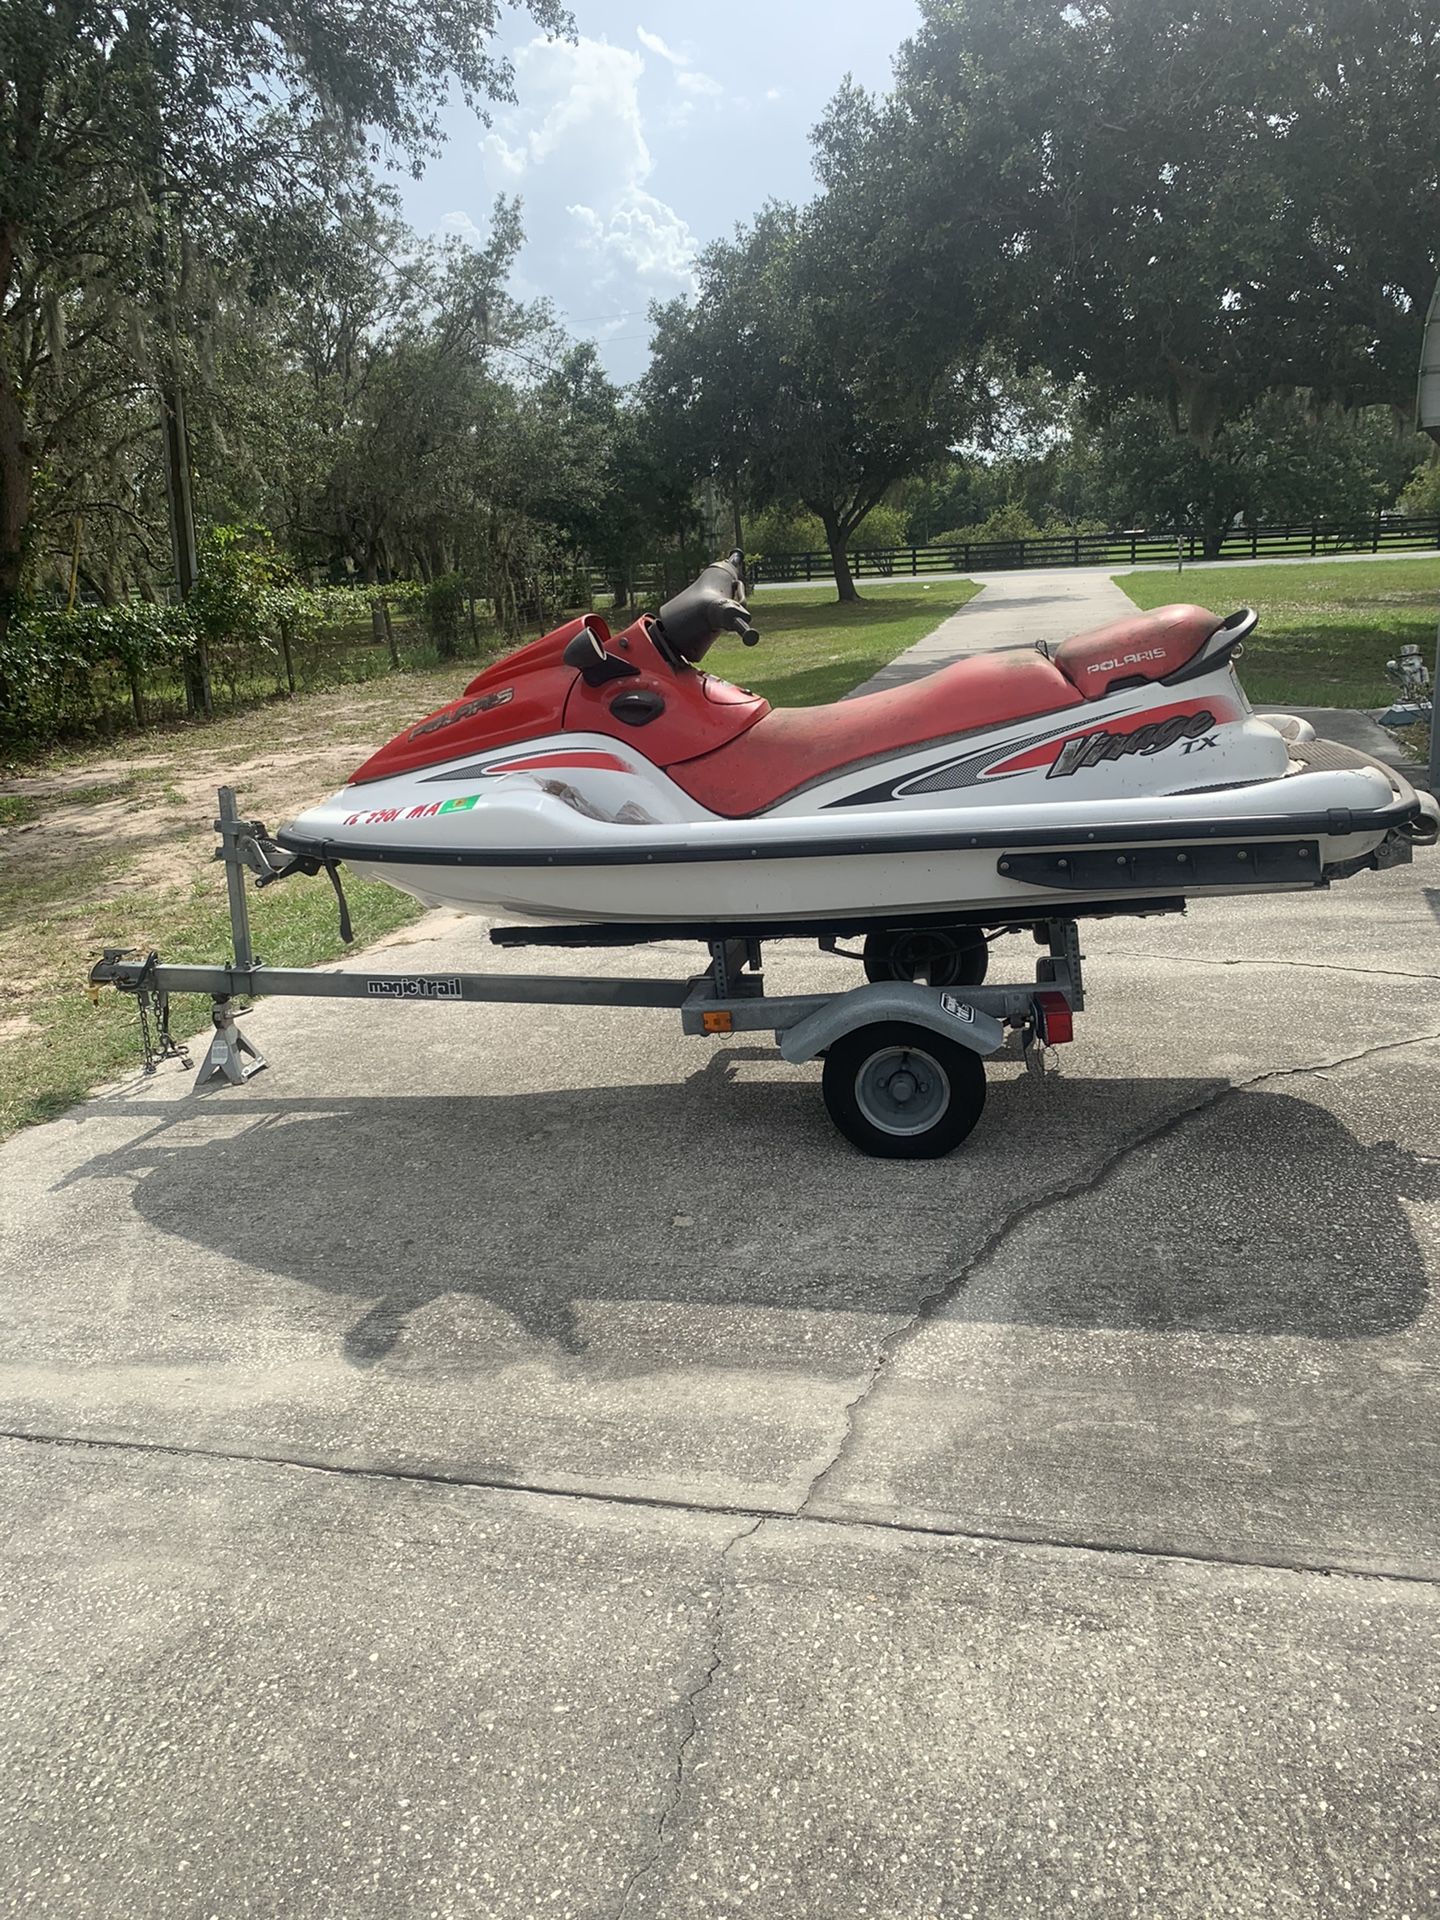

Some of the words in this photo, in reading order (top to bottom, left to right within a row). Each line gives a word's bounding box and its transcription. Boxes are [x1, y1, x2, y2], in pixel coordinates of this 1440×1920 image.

[1086, 647, 1167, 674] POLARIS
[1045, 710, 1217, 780] Virage
[1179, 733, 1221, 757] TX
[405, 800, 444, 820] MA
[367, 977, 463, 998] magictrail
